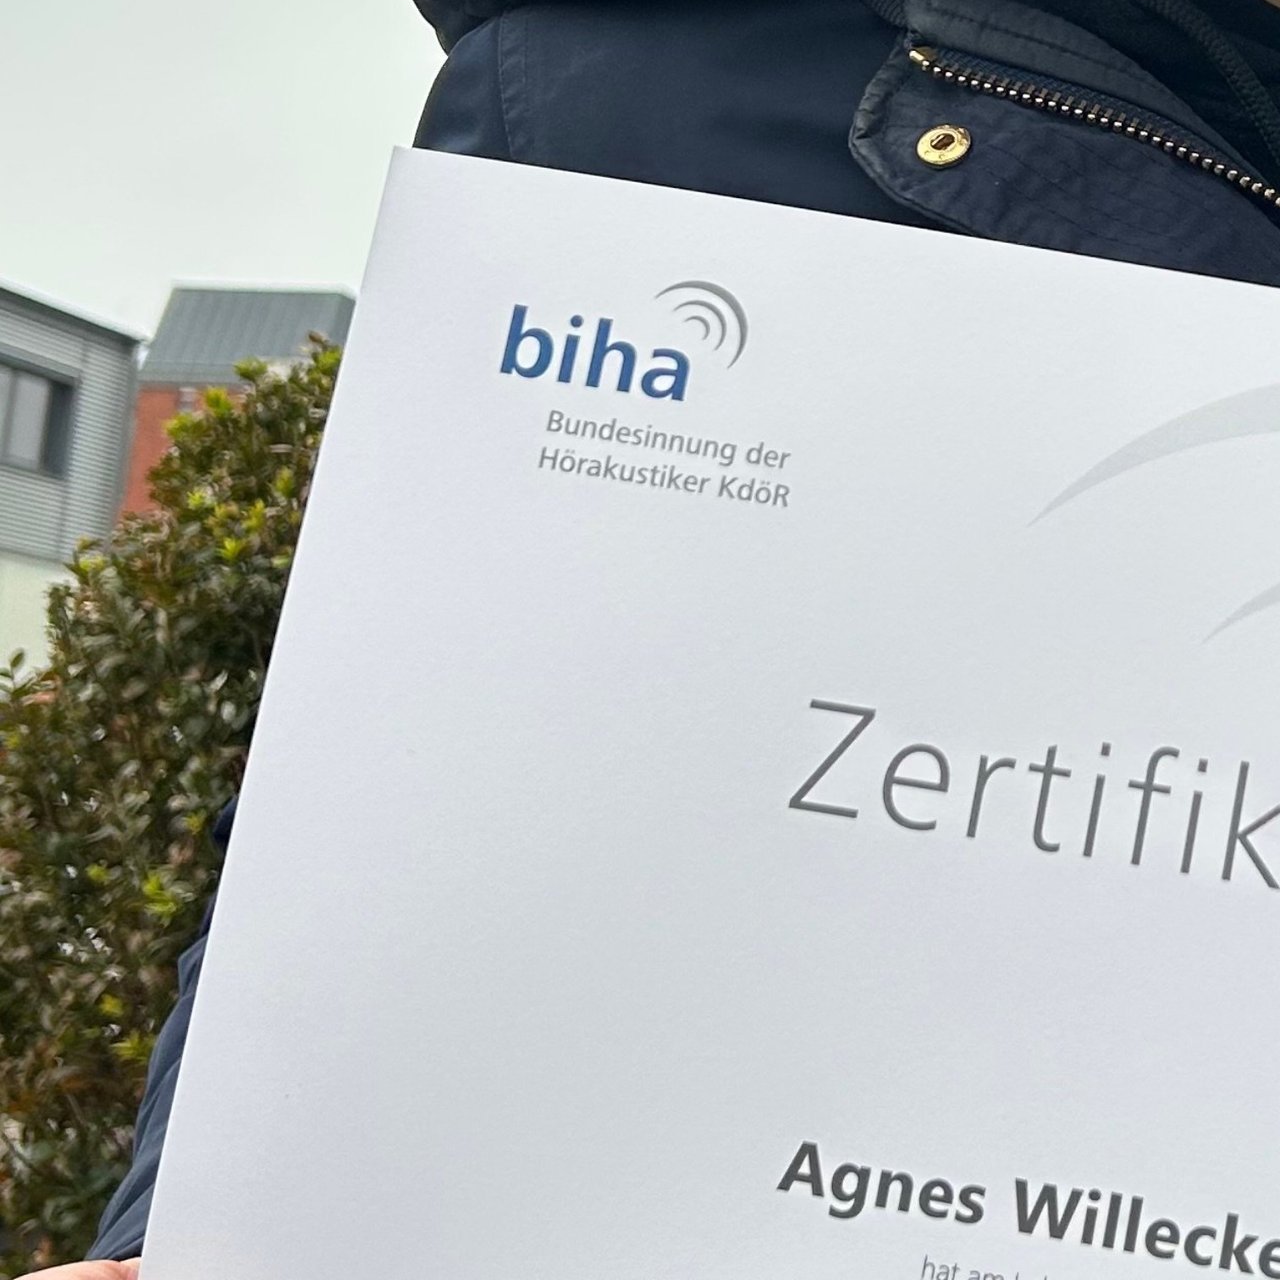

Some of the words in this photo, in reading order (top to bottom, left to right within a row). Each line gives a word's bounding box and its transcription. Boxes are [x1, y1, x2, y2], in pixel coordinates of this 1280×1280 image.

[500, 304, 691, 401] biha
[545, 409, 737, 467] Bundesinnung
[745, 442, 791, 470] der
[538, 446, 710, 494] Hörakustiker
[717, 475, 790, 508] KdöR
[777, 1140, 986, 1224] Agnes
[921, 1254, 960, 1280] hat
